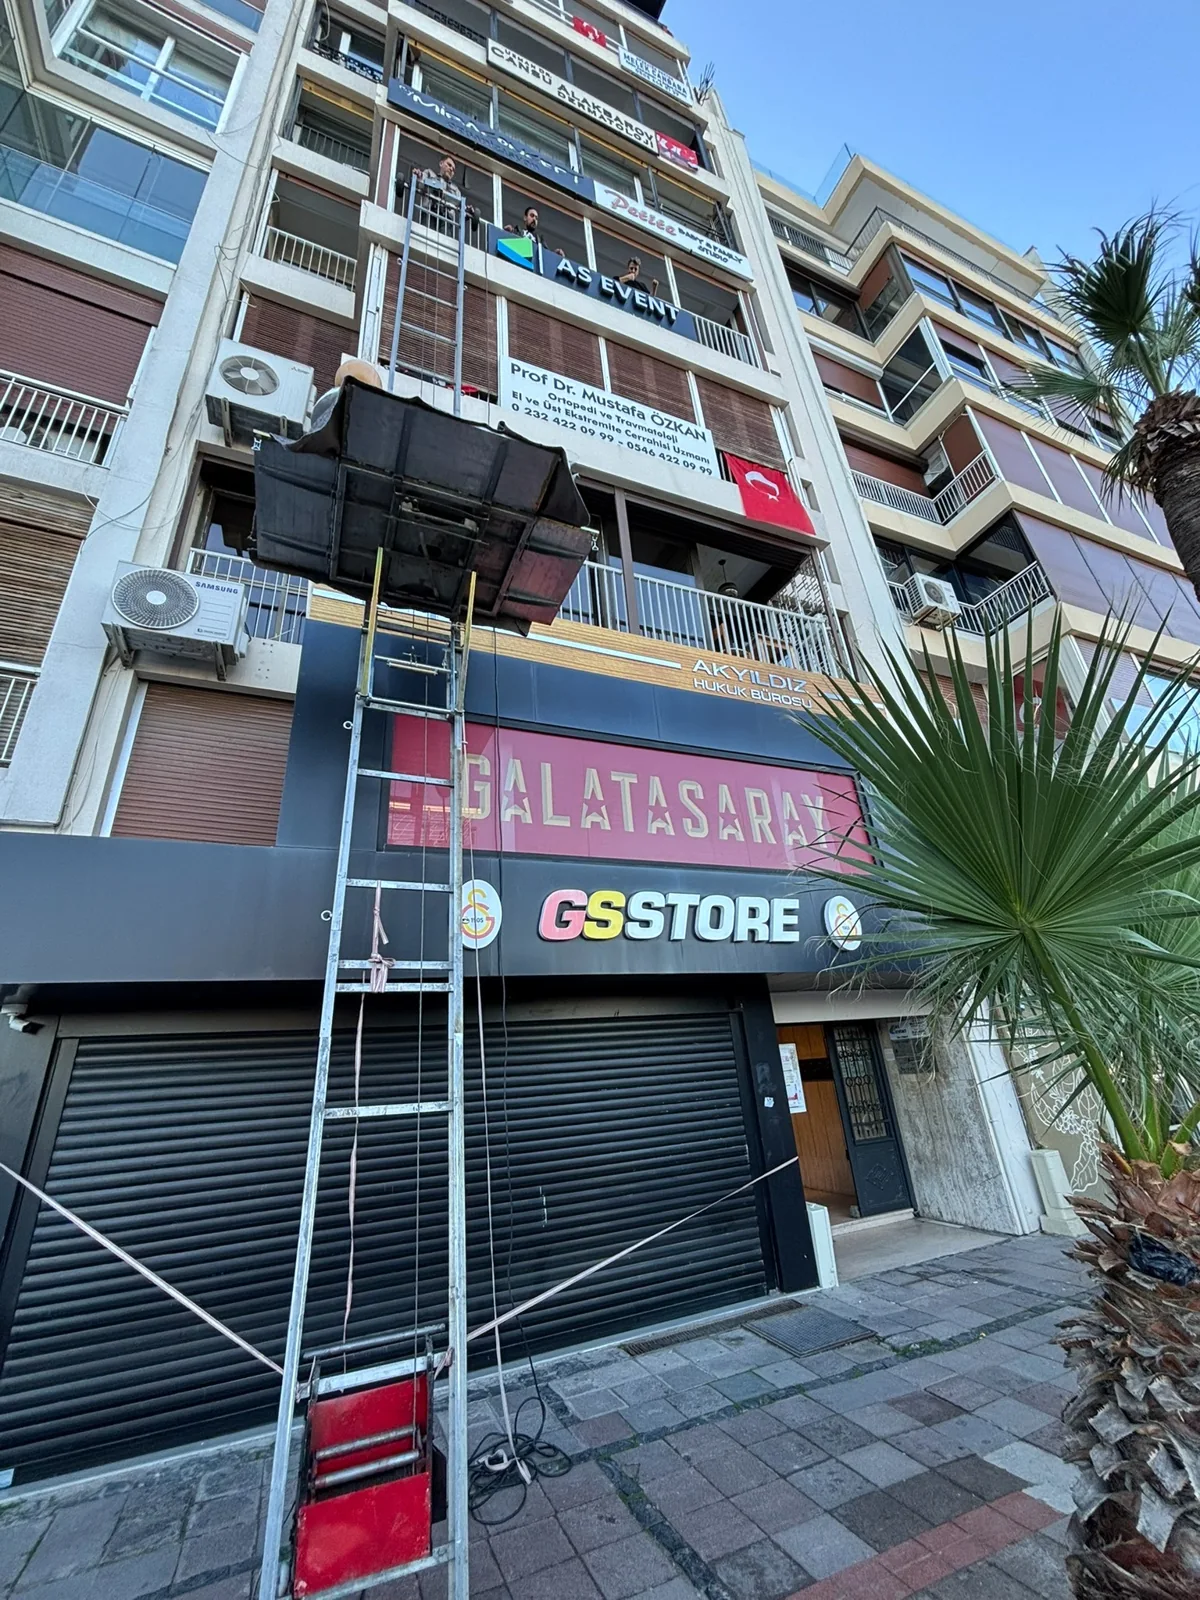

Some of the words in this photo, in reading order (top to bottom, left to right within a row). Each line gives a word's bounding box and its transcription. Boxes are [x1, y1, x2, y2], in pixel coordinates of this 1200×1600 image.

[490, 46, 552, 86] CANSU
[557, 83, 654, 141] ALAKBAROV
[697, 245, 729, 263] STUDIO
[556, 257, 593, 286] AS
[600, 274, 680, 322] EVENT
[511, 403, 520, 412] 0
[524, 407, 549, 422] 232
[552, 417, 577, 431] 422
[580, 425, 596, 437] 09
[599, 431, 615, 442] 99
[627, 440, 656, 458] 0546
[658, 452, 681, 466] 422
[683, 459, 697, 471] 09
[699, 465, 713, 477] 99
[512, 390, 523, 401] El
[525, 396, 539, 407] ve
[543, 399, 562, 414] Üst
[564, 408, 622, 434] Ekstremite
[624, 428, 671, 452] Cerrahisi
[547, 392, 597, 416] Ortopedi
[599, 410, 613, 420] ve
[615, 415, 679, 444] Travmatoloji
[553, 377, 577, 396] Dr.
[582, 387, 646, 421] Mustafa
[650, 410, 707, 443] ÖZKAN
[195, 581, 239, 595] SAMSUNG
[692, 659, 807, 693] AKYILDIZ
[693, 677, 748, 698] HUKUK
[750, 688, 813, 709] BÜROSU
[461, 753, 828, 849] GALATASARAY
